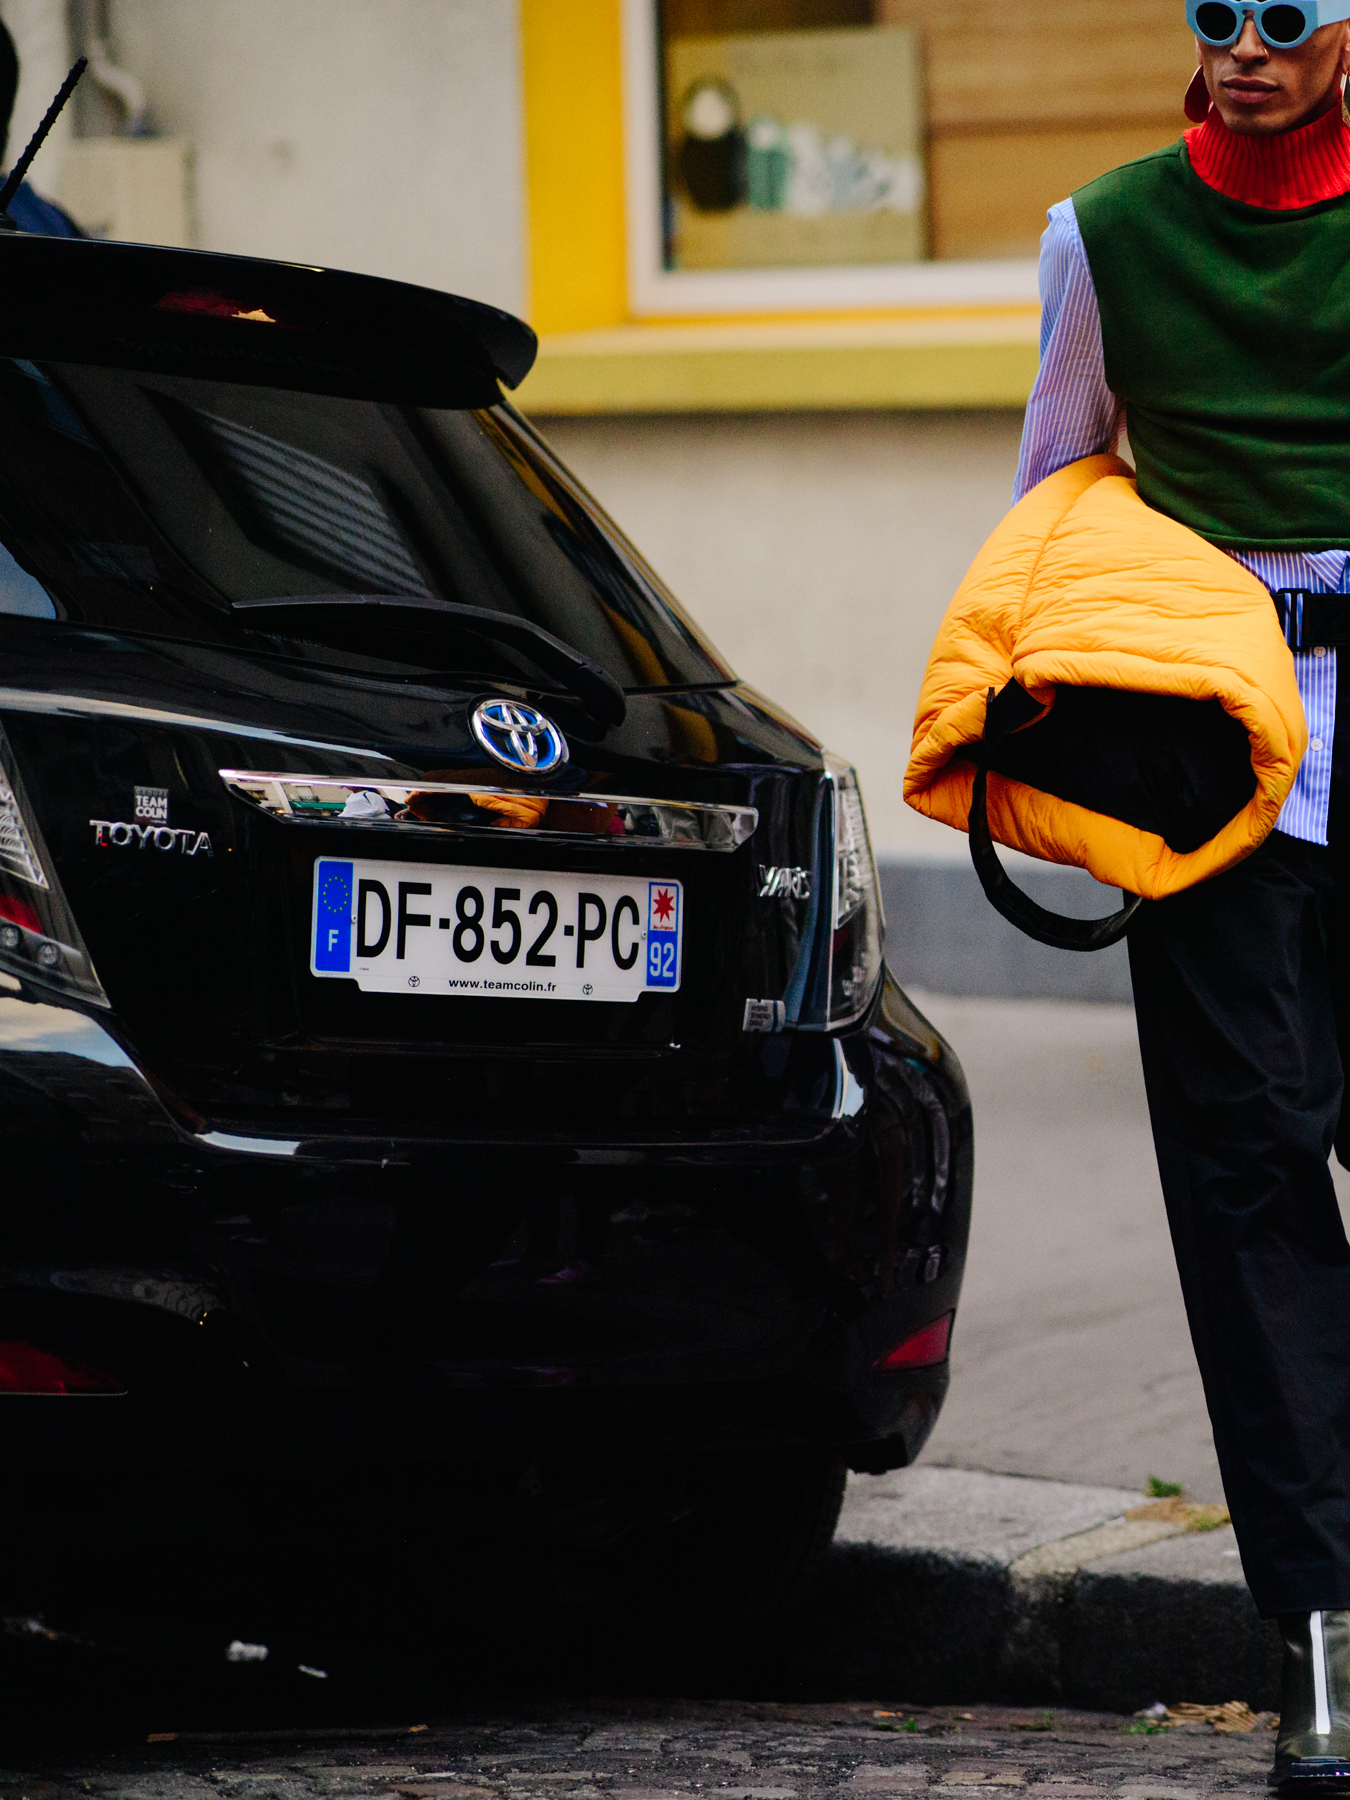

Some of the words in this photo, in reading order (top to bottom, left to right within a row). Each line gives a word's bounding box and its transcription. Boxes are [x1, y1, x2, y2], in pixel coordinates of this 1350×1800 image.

[135, 795, 168, 808] TEAM
[89, 819, 214, 858] TOYOTA
[356, 878, 640, 971] DF-852-PC
[328, 929, 339, 952] F
[649, 941, 675, 978] 92
[448, 979, 557, 993] www.teamcolin.fr
